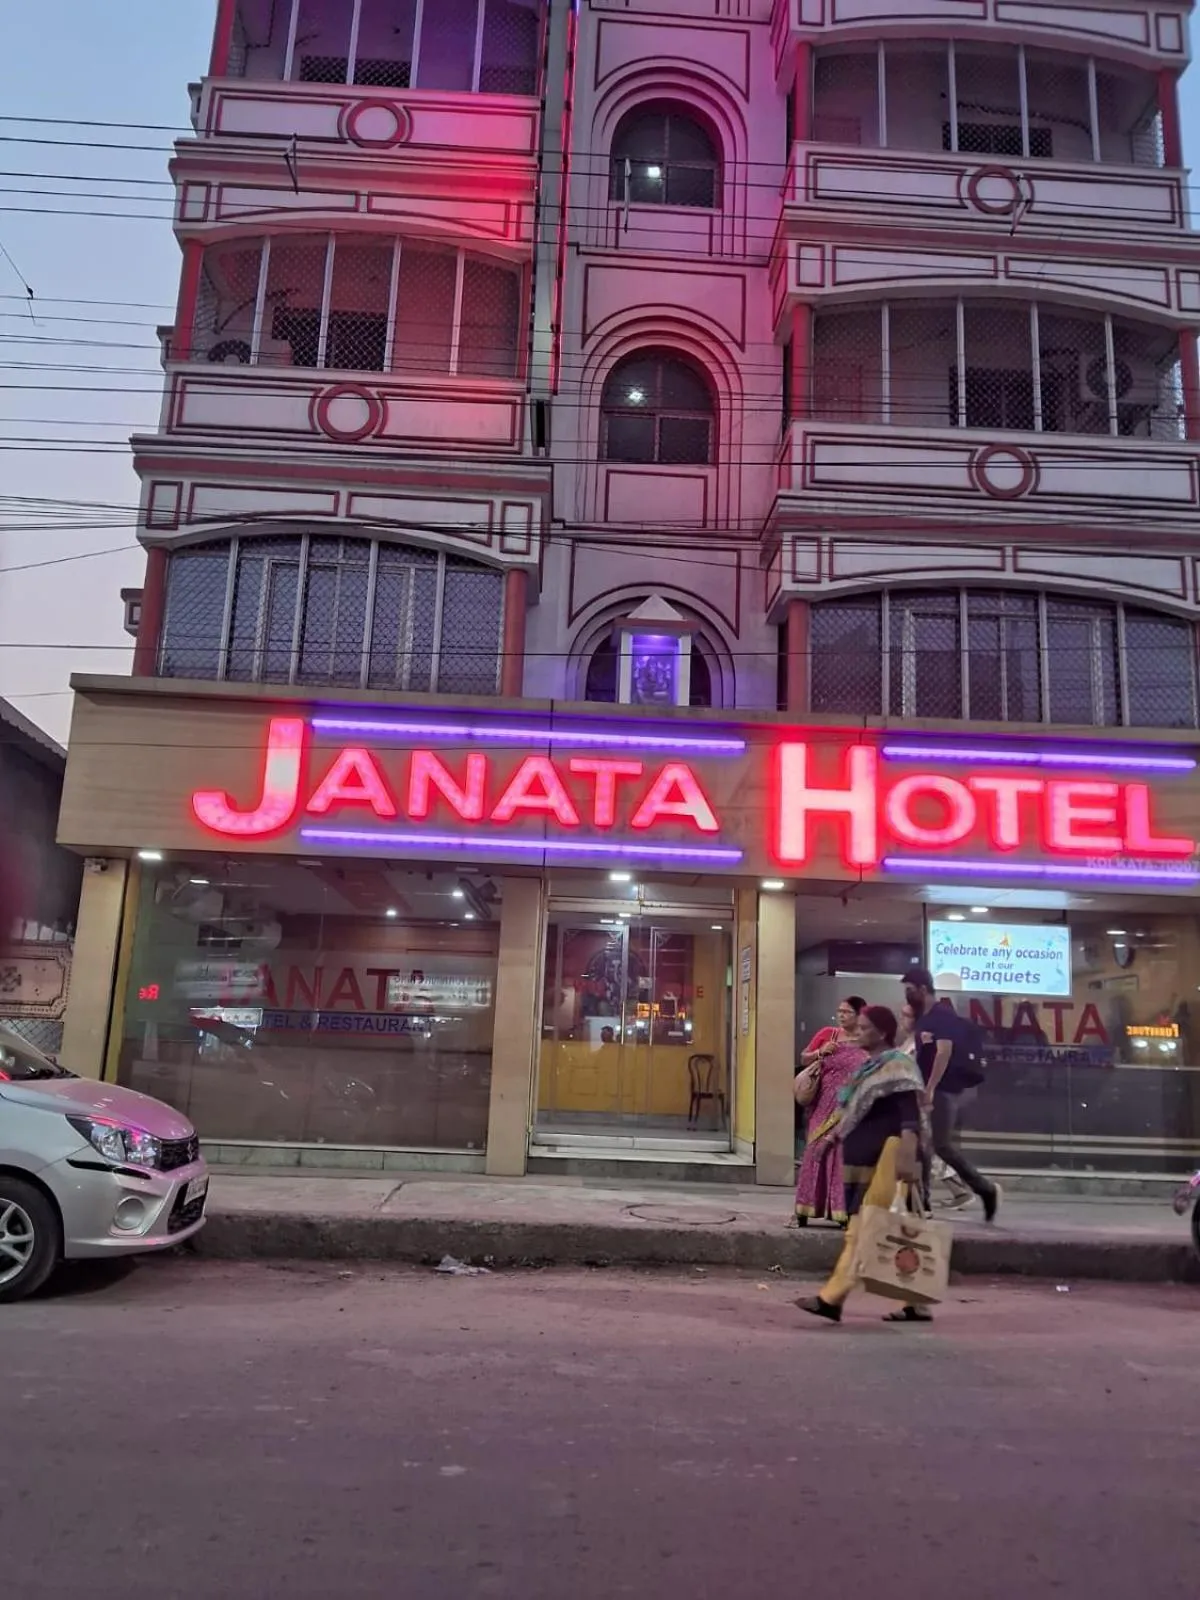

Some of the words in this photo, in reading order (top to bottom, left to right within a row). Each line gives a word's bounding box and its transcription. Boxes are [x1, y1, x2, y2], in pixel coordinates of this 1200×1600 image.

[192, 718, 719, 837] JANATA
[779, 742, 1195, 863] HOTEL
[936, 943, 989, 956] Celebrate
[992, 948, 1012, 959] any
[1016, 948, 1063, 960] occasion
[985, 961, 995, 969] at
[960, 967, 1041, 985] Banquets
[301, 1015, 312, 1031] &
